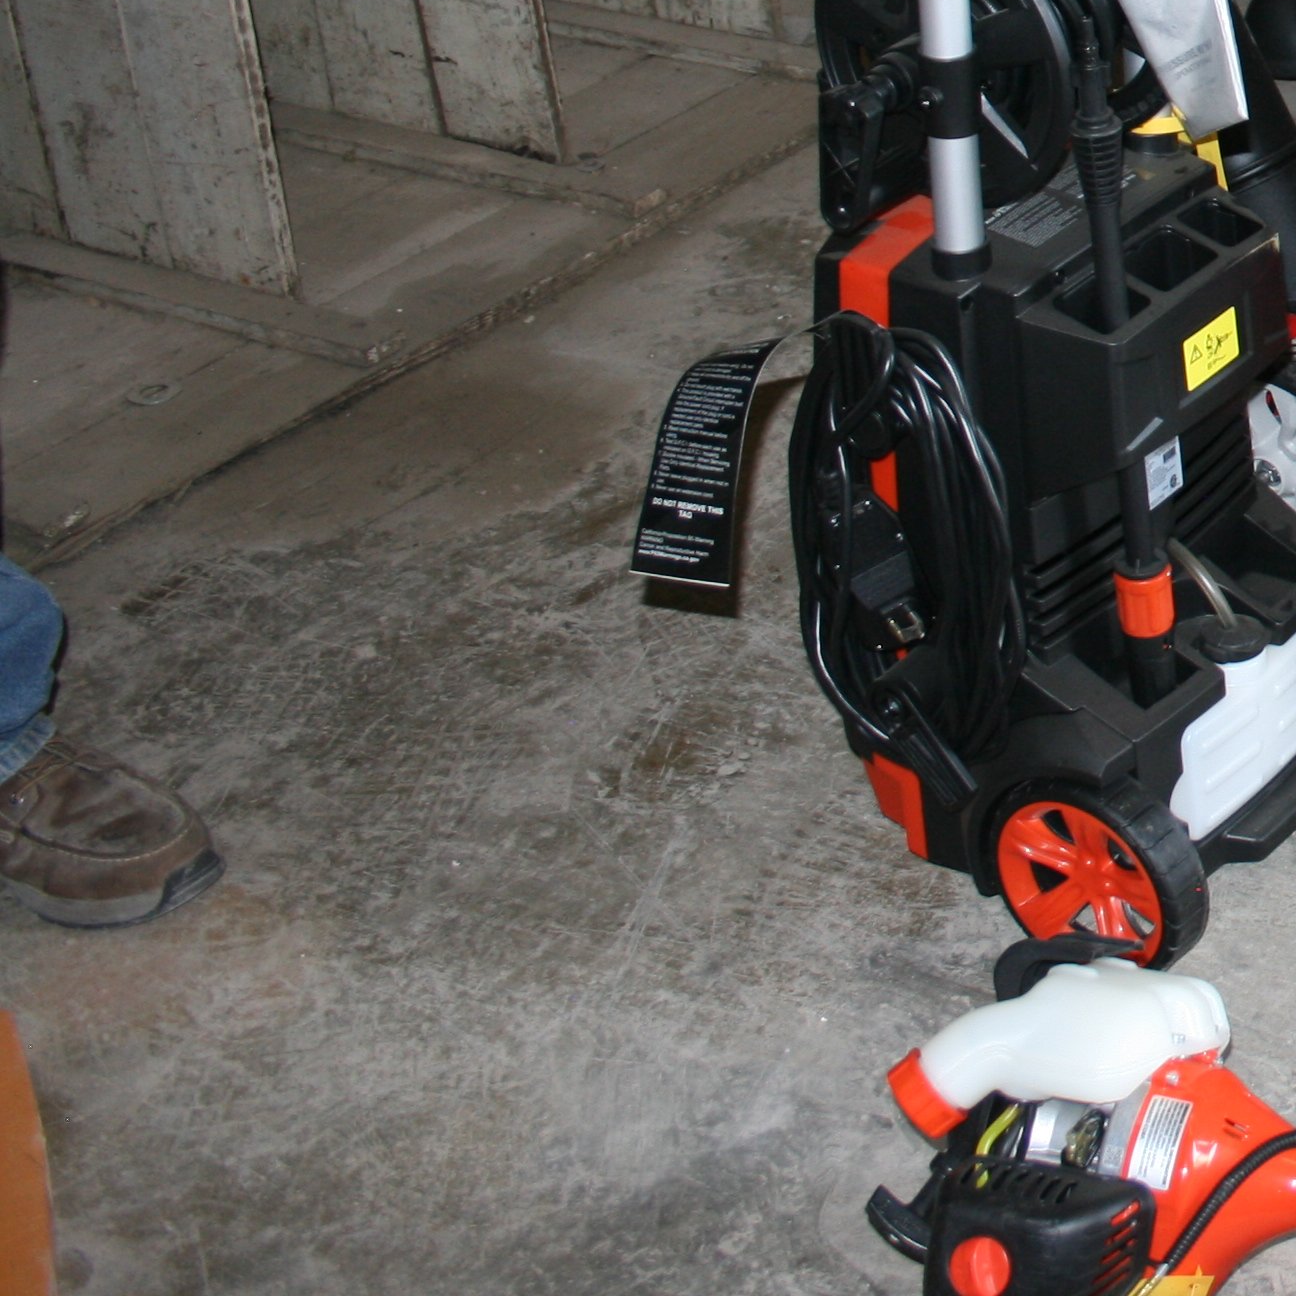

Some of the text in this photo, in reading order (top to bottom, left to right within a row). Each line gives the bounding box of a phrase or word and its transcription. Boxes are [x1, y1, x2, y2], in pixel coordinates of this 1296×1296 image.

[652, 497, 724, 515] DO NOT REMOVE THIS
[678, 510, 692, 519] TAG
